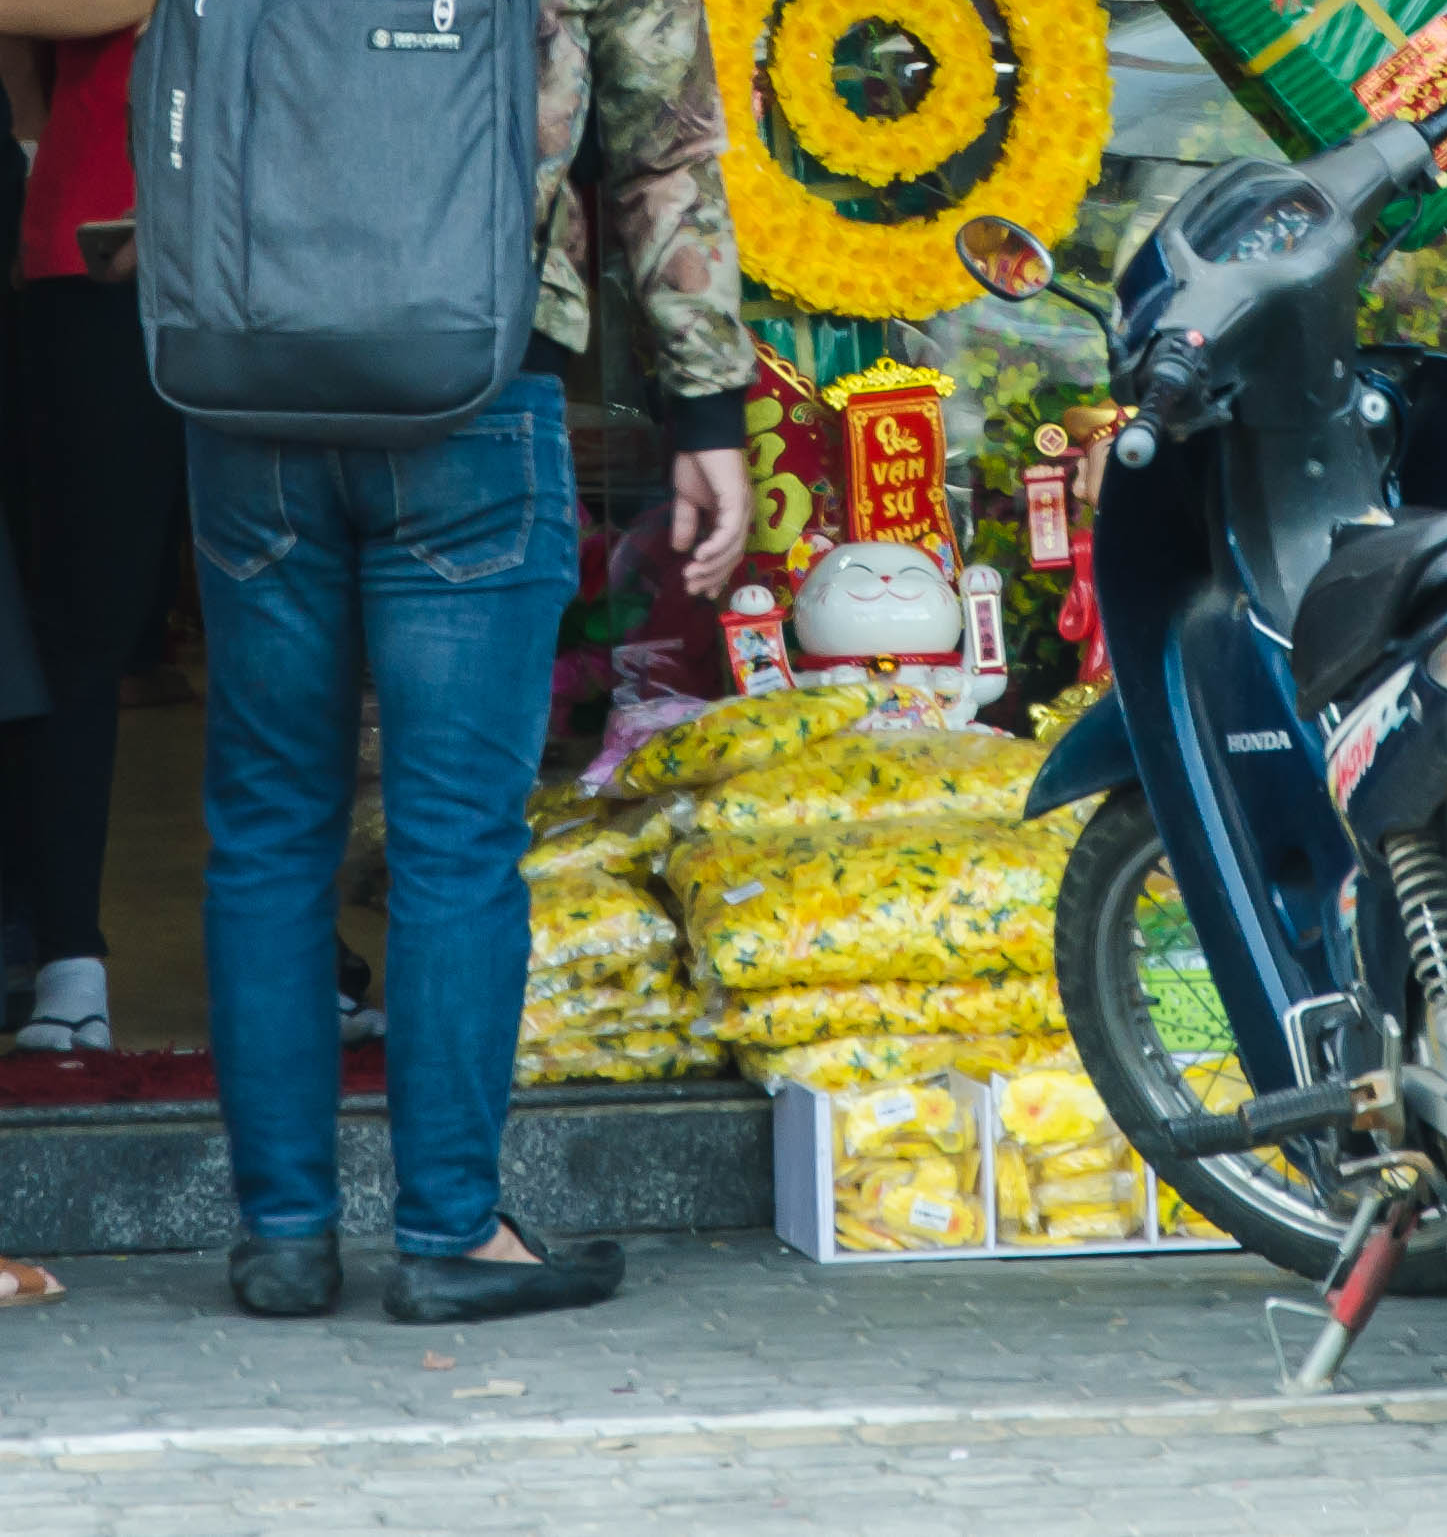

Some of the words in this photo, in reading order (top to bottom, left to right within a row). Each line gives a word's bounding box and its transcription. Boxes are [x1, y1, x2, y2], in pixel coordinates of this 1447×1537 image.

[872, 458, 925, 487] VẠN
[881, 486, 916, 520] SỰ
[1227, 730, 1292, 753] HONDA
